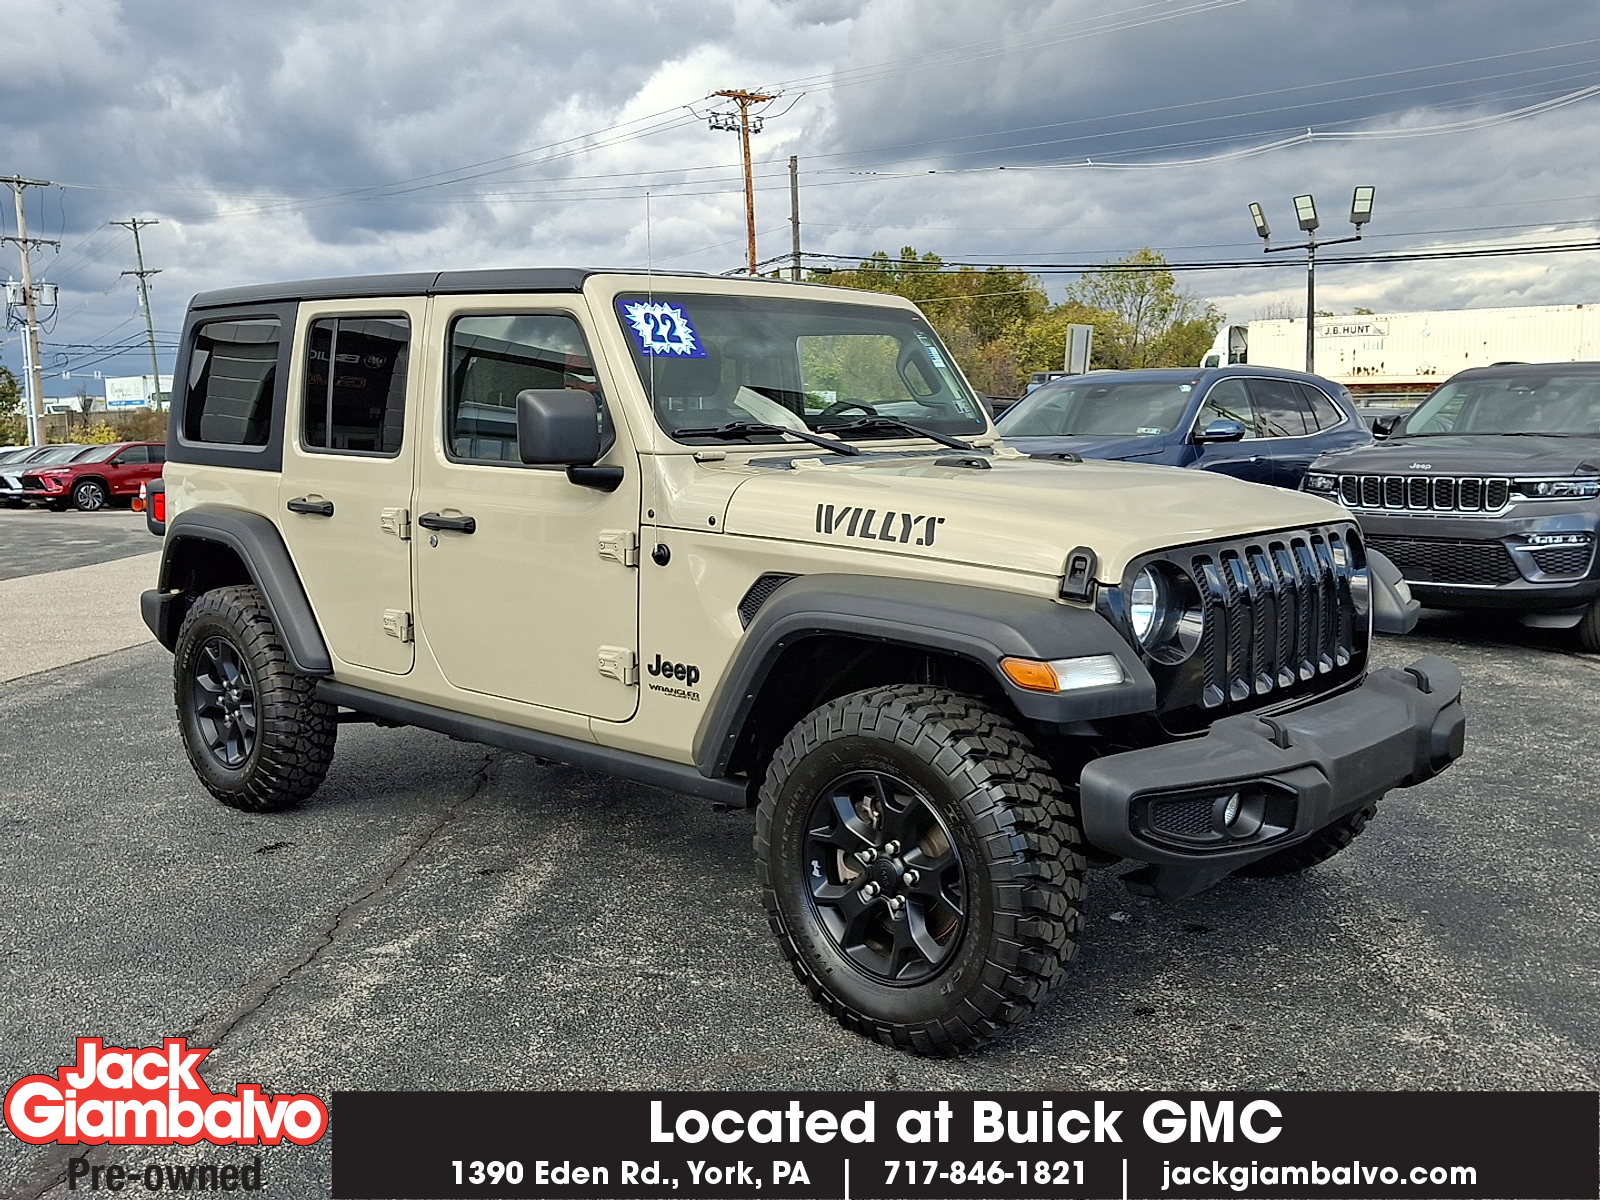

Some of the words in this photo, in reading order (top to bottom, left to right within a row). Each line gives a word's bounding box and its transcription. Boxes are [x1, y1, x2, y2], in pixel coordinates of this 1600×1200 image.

[643, 312, 683, 344] 22
[1343, 325, 1371, 334] HUNT
[1408, 462, 1432, 470] Jeep
[816, 503, 946, 547] WILLYS
[647, 653, 700, 687] Jeep
[648, 683, 700, 699] WRANGLER
